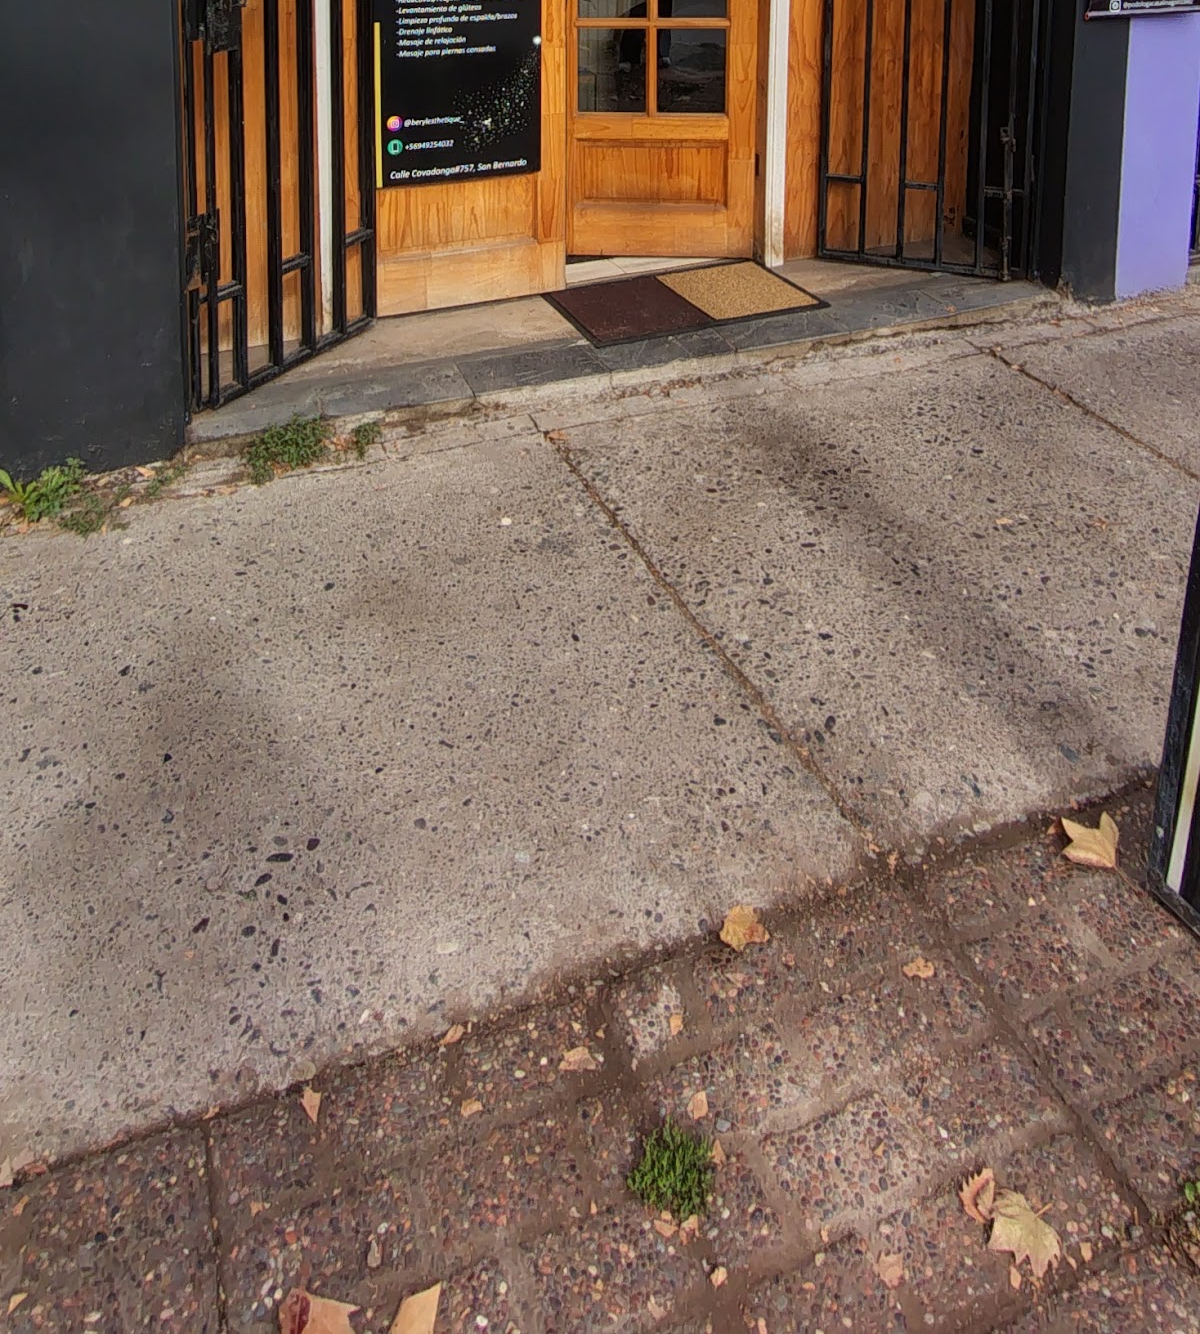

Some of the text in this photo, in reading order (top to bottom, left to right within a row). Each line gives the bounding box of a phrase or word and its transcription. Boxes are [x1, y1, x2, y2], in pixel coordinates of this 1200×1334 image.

[448, 4, 457, 12] de
[429, 15, 459, 24] profunda
[460, 14, 469, 22] de
[425, 37, 434, 45] de
[424, 48, 441, 57] para
[441, 47, 466, 56] piernas
[466, 45, 496, 54] cansadas
[390, 170, 410, 180] Calle
[477, 162, 492, 171] San
[492, 158, 528, 169] Bernardo
